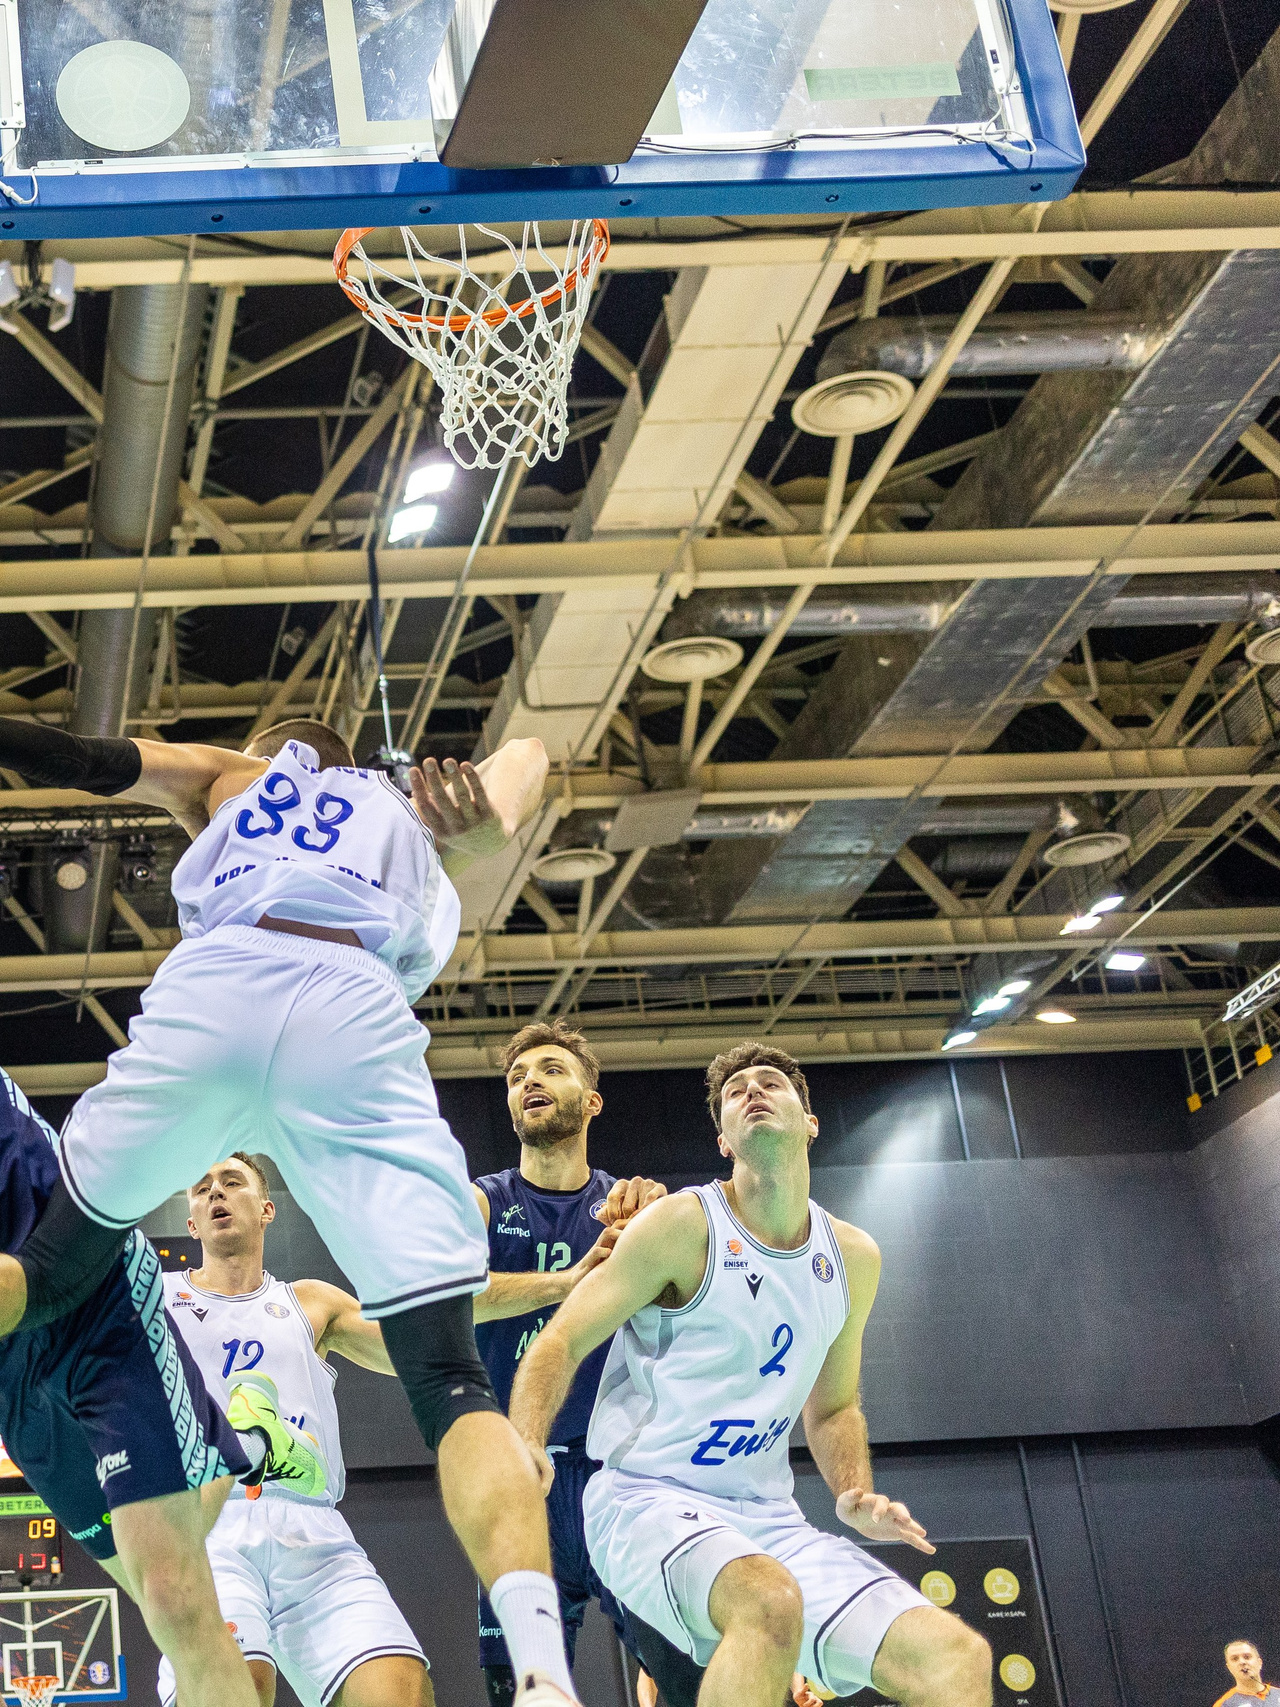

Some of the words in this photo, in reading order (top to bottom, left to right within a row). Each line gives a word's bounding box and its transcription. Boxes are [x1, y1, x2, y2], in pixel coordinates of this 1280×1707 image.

[235, 772, 353, 854] 33
[497, 1223, 531, 1238] Kempa
[536, 1242, 572, 1273] 12
[222, 1338, 264, 1379] 12
[759, 1323, 793, 1377] 2
[28, 1518, 56, 1539] 09
